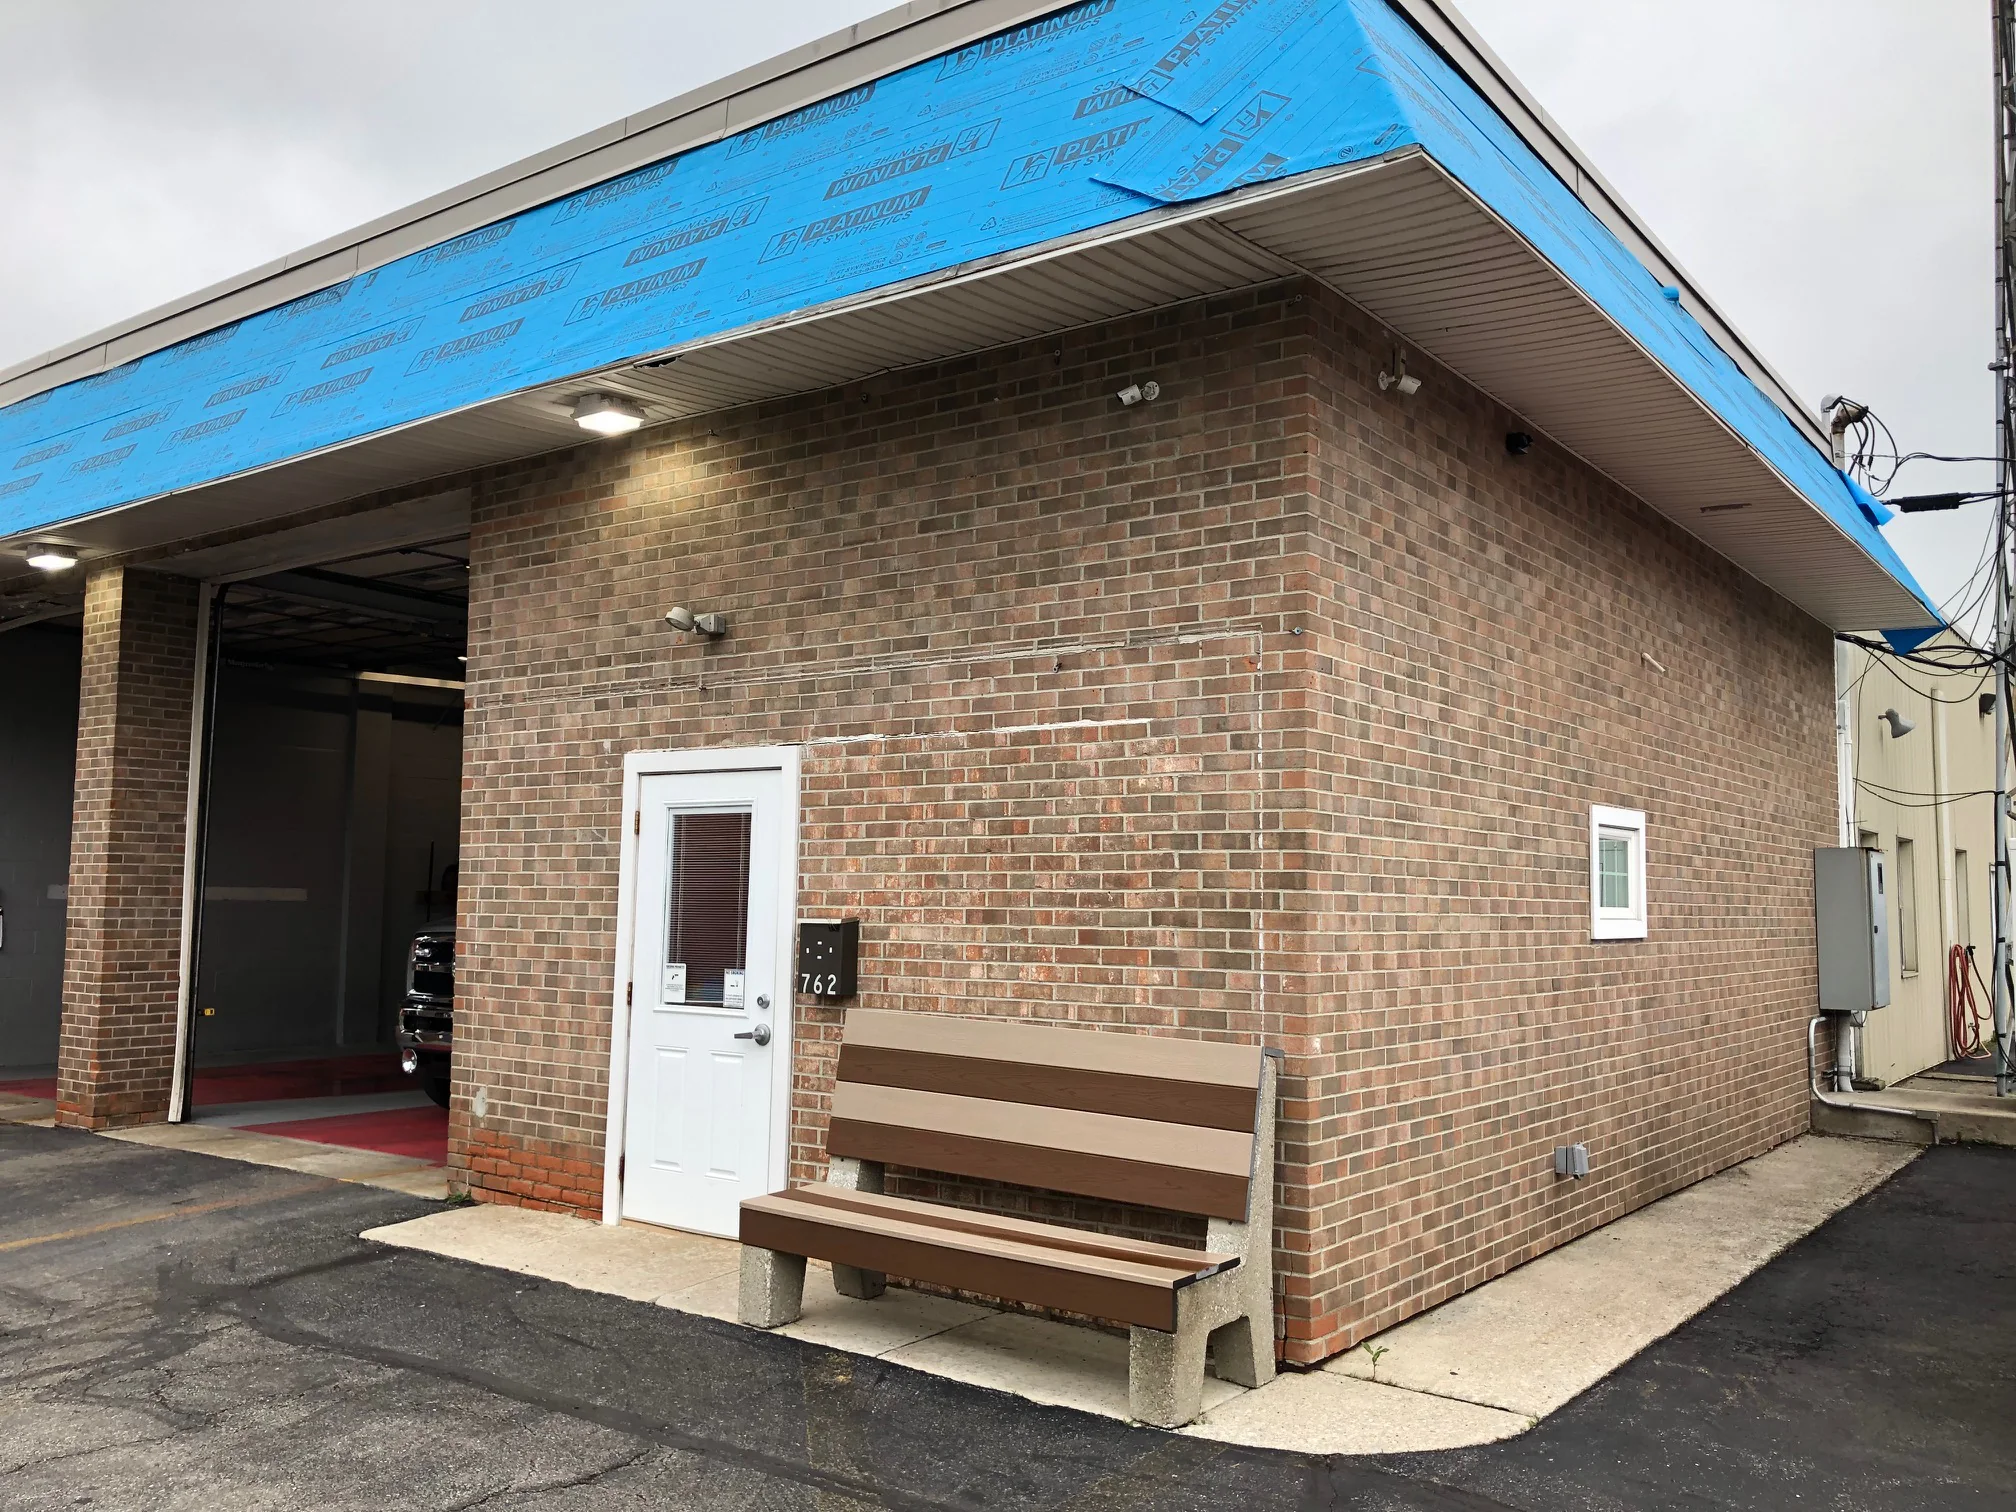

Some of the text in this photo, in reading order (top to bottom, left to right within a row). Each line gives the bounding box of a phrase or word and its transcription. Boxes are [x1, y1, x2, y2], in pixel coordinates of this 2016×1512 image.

[983, 16, 1103, 65] FT SYNTHETICS
[985, 1, 1110, 54] PLATINUM
[1182, 48, 1200, 68] FT
[763, 105, 860, 147] FT SYNTHETICS
[770, 87, 870, 136] PLATINUM
[930, 134, 950, 148] FT
[1192, 143, 1210, 164] FT
[832, 147, 945, 197] PLATINUM
[842, 142, 929, 177] SYNTHETICS
[1057, 158, 1083, 175] FT
[592, 163, 674, 205] PLATINUM
[803, 210, 914, 251] FT SYNTHETICS
[809, 189, 923, 236] PLATINUM
[441, 224, 511, 260] PLATINUM
[631, 219, 719, 262] PLATINUM
[600, 280, 690, 315] FT SYNTHETICS
[606, 262, 698, 304] PLATINUM
[463, 284, 541, 321] PLATINUM
[326, 335, 393, 367] PLATINUM
[441, 321, 519, 357] PLATINUM
[302, 370, 368, 400] PLATINUM
[801, 973, 836, 995] 762
